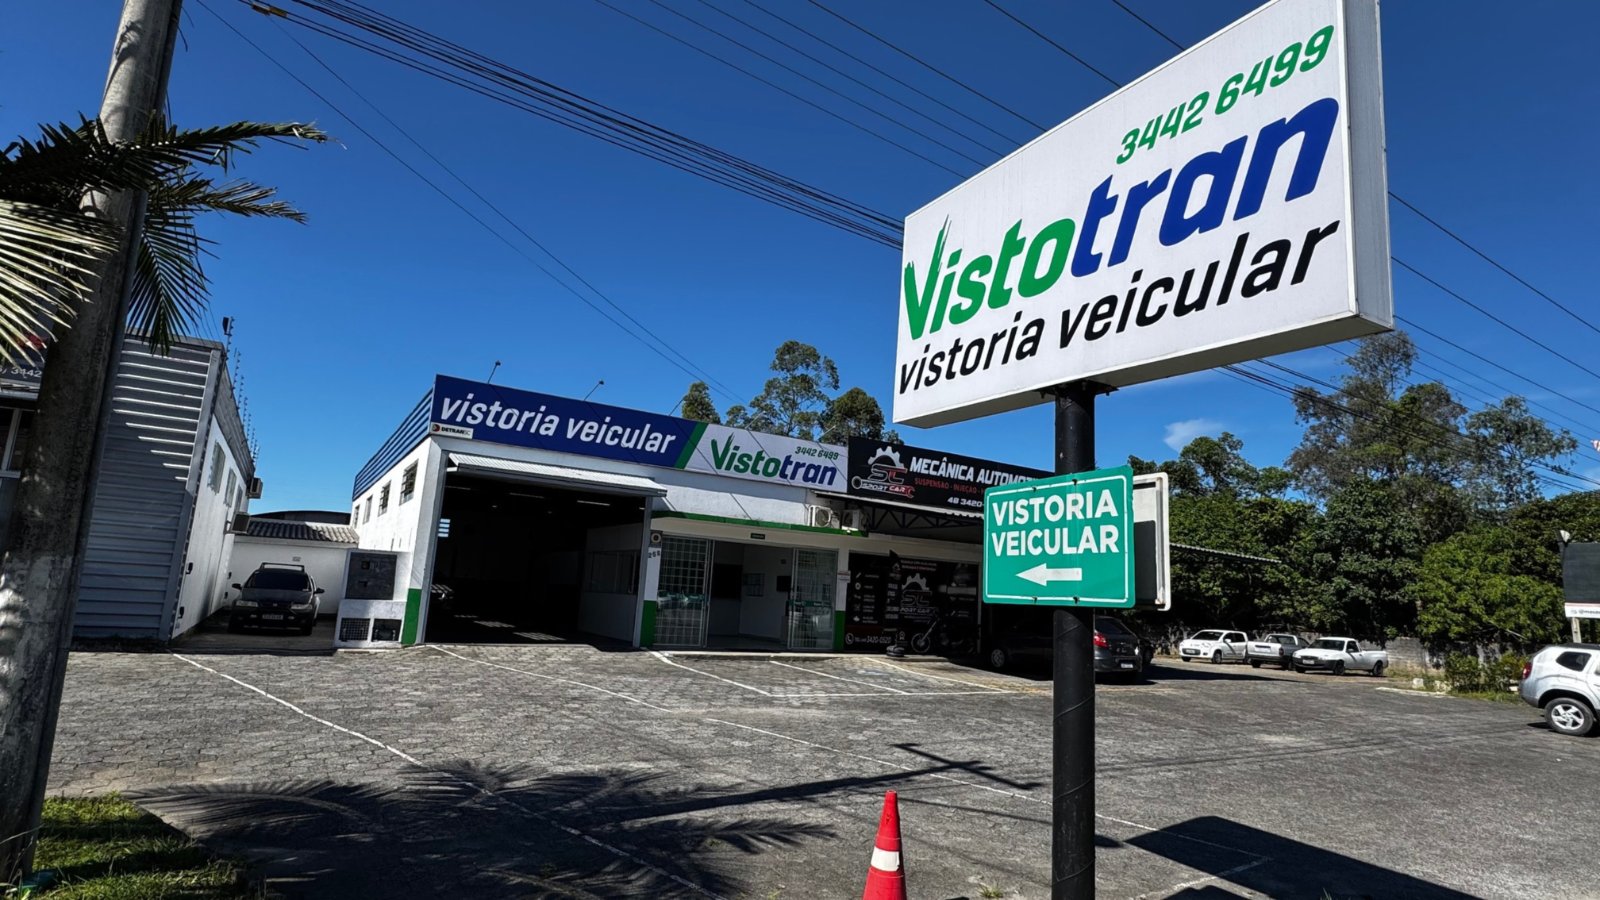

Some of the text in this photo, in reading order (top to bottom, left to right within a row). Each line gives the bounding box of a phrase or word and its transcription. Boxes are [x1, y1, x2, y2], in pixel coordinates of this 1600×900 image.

[1116, 25, 1335, 165] 3442 6499
[904, 97, 1340, 341] Vistotran
[899, 220, 1341, 395] vistoria veicular
[441, 393, 677, 454] vistoria veicular
[710, 432, 837, 486] Vistotran
[795, 446, 839, 460] 3442 6499
[909, 456, 1039, 486] MECÂNICA AUTOMO
[992, 489, 1119, 526] VISTORIA
[992, 524, 1119, 557] VEICULAR
